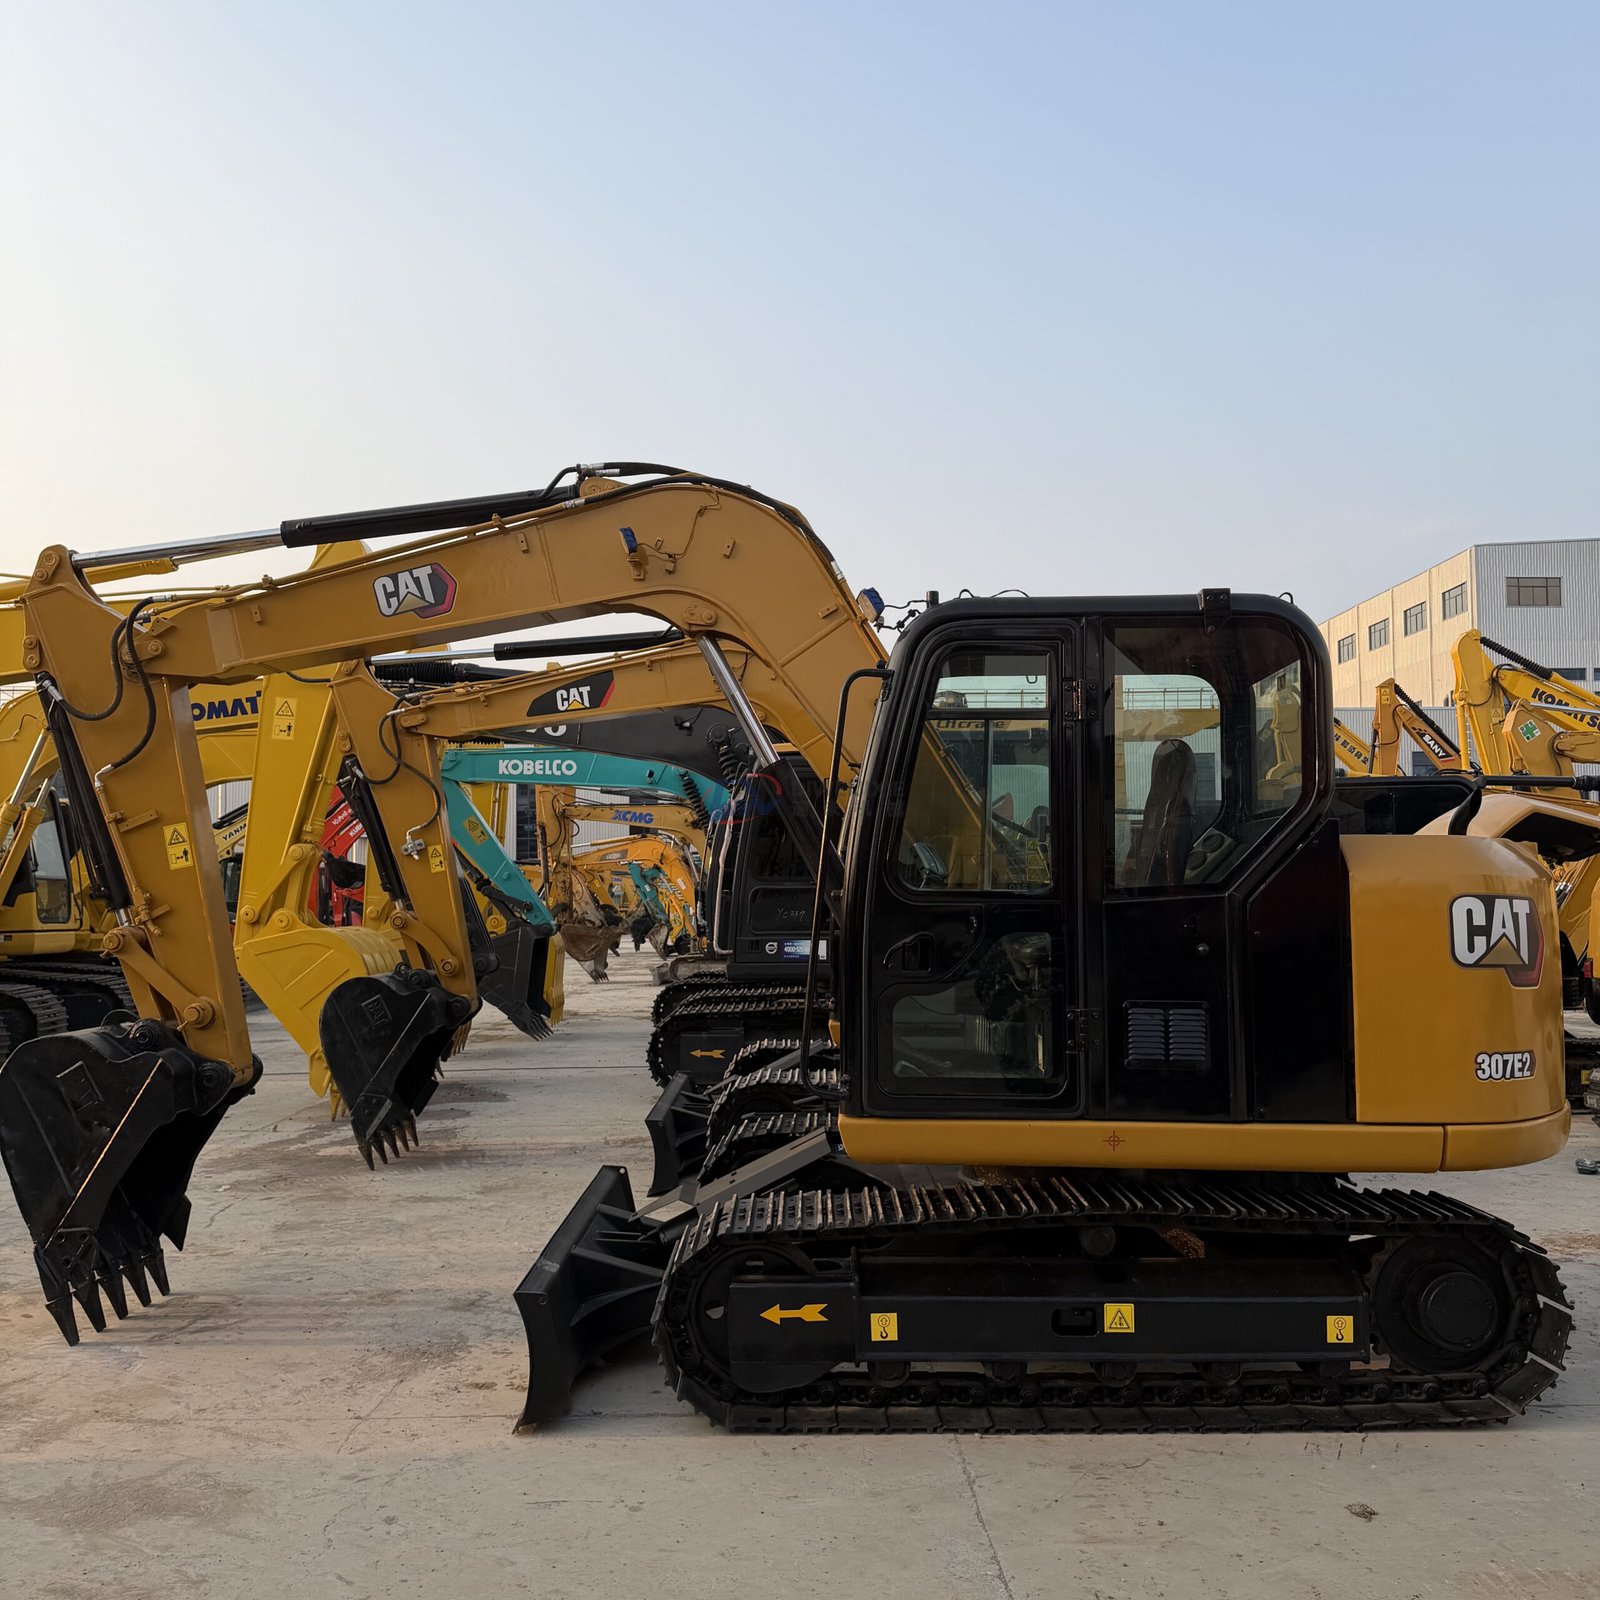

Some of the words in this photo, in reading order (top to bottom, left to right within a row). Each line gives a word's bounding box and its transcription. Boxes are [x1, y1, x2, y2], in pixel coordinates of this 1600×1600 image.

[374, 565, 435, 616] CAT
[556, 686, 591, 711] CAT
[1422, 734, 1446, 758] SANY
[498, 759, 577, 775] KOBELCO
[611, 809, 655, 825] XCMG
[1452, 896, 1530, 965] CAT
[1476, 1052, 1532, 1081] 307E2
